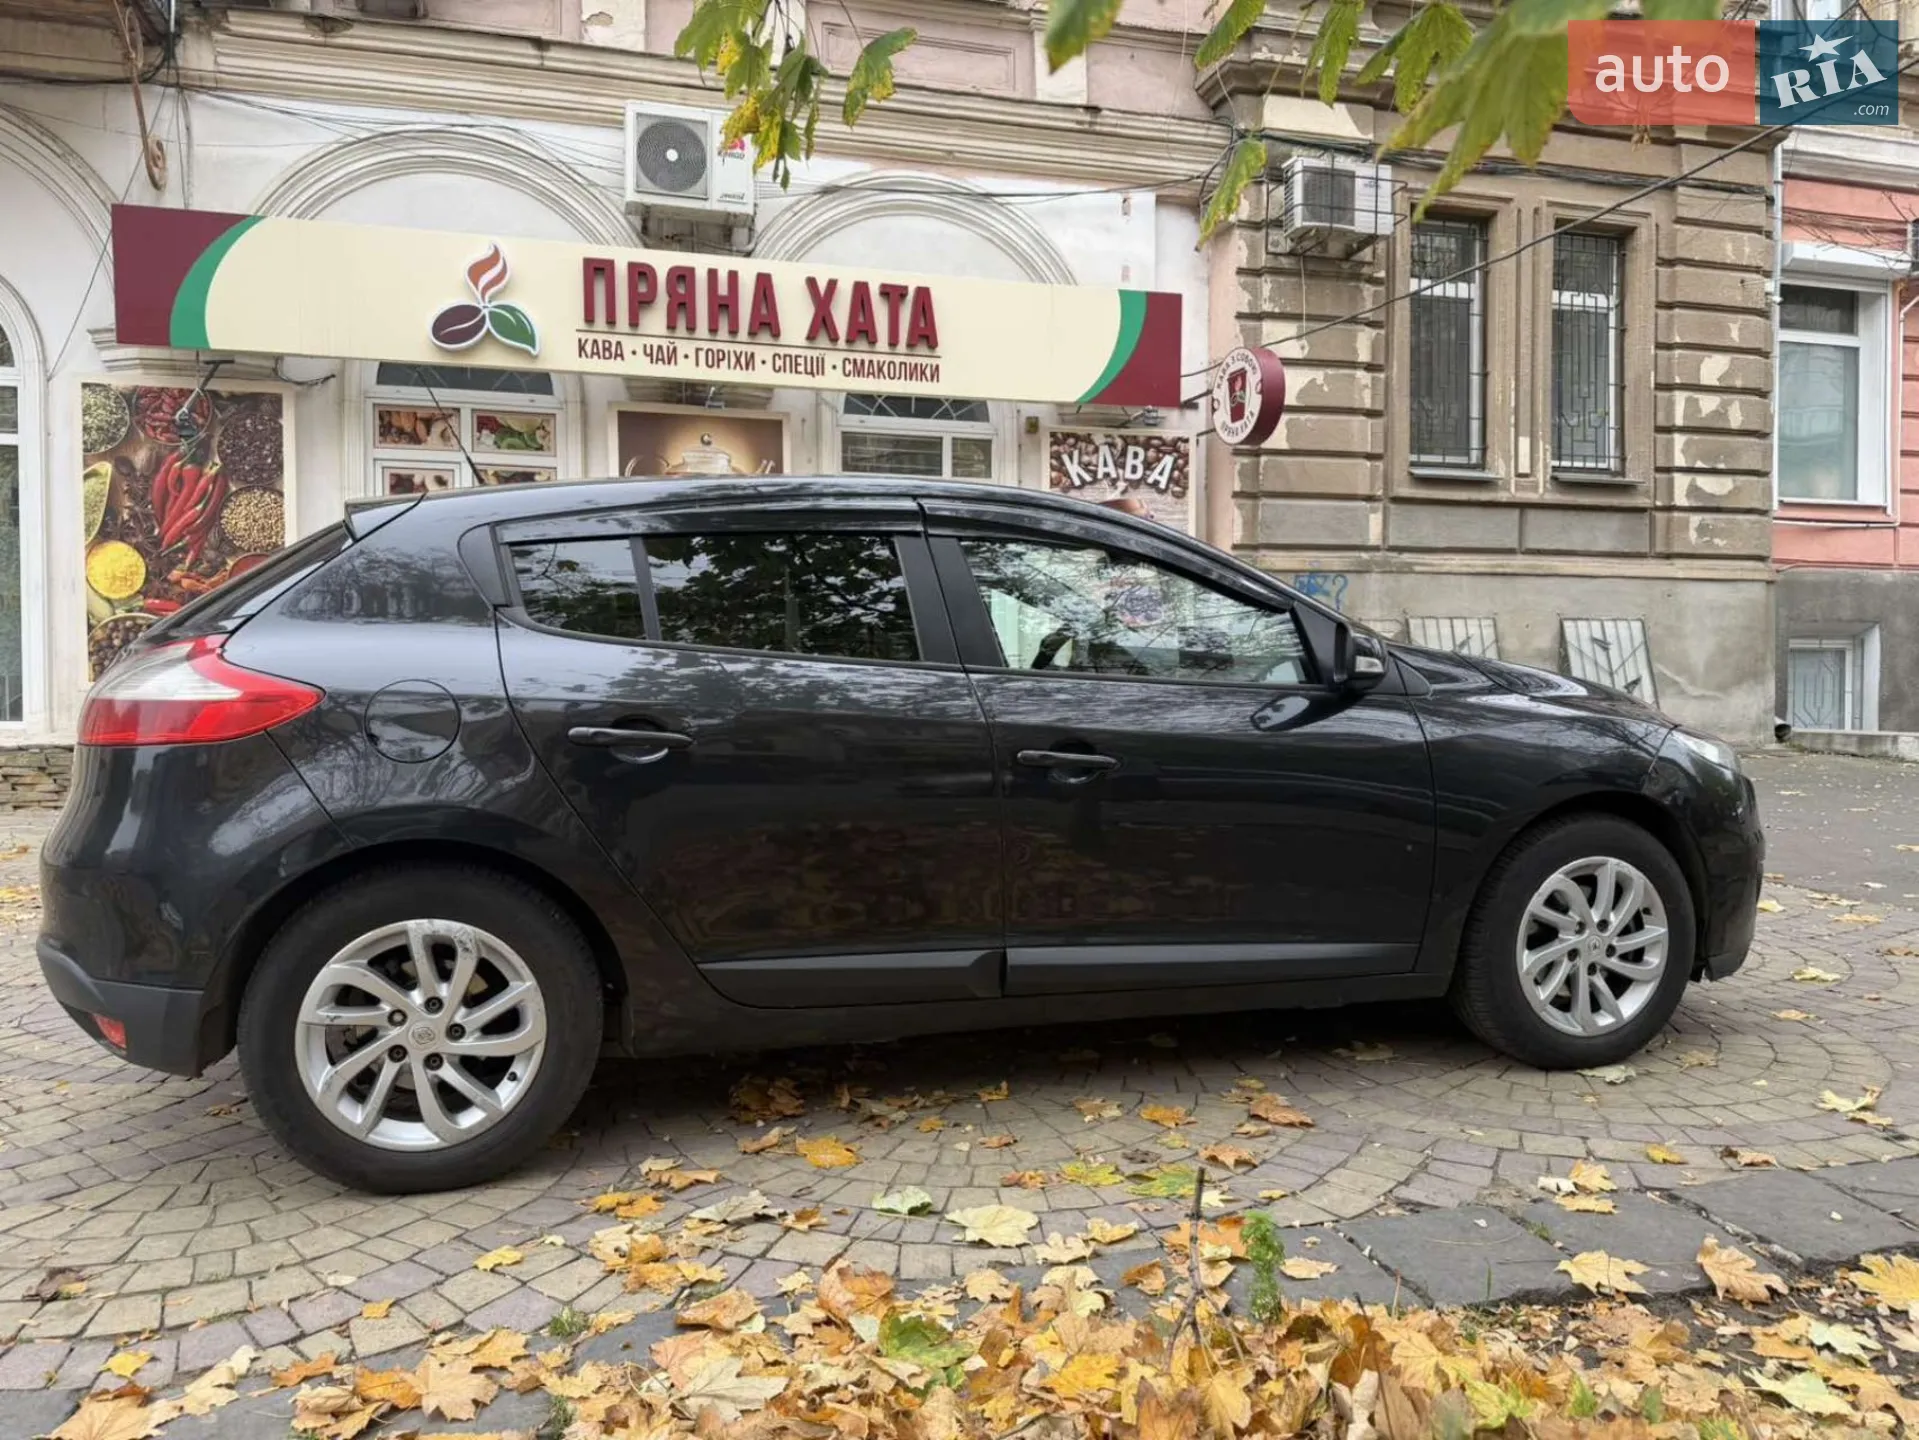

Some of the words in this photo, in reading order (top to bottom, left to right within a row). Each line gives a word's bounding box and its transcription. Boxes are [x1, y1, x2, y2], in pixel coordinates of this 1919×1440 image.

[582, 257, 781, 339] ПРЯНА
[804, 276, 939, 350] ХАТА
[577, 337, 625, 361] КАВА
[642, 341, 678, 367] ЧАЙ
[694, 346, 756, 372] ГОРІХИ
[772, 351, 826, 379] СПЕЦІЇ
[841, 357, 941, 384] СМАКОЛИКИ
[1061, 443, 1177, 490] КАВА
